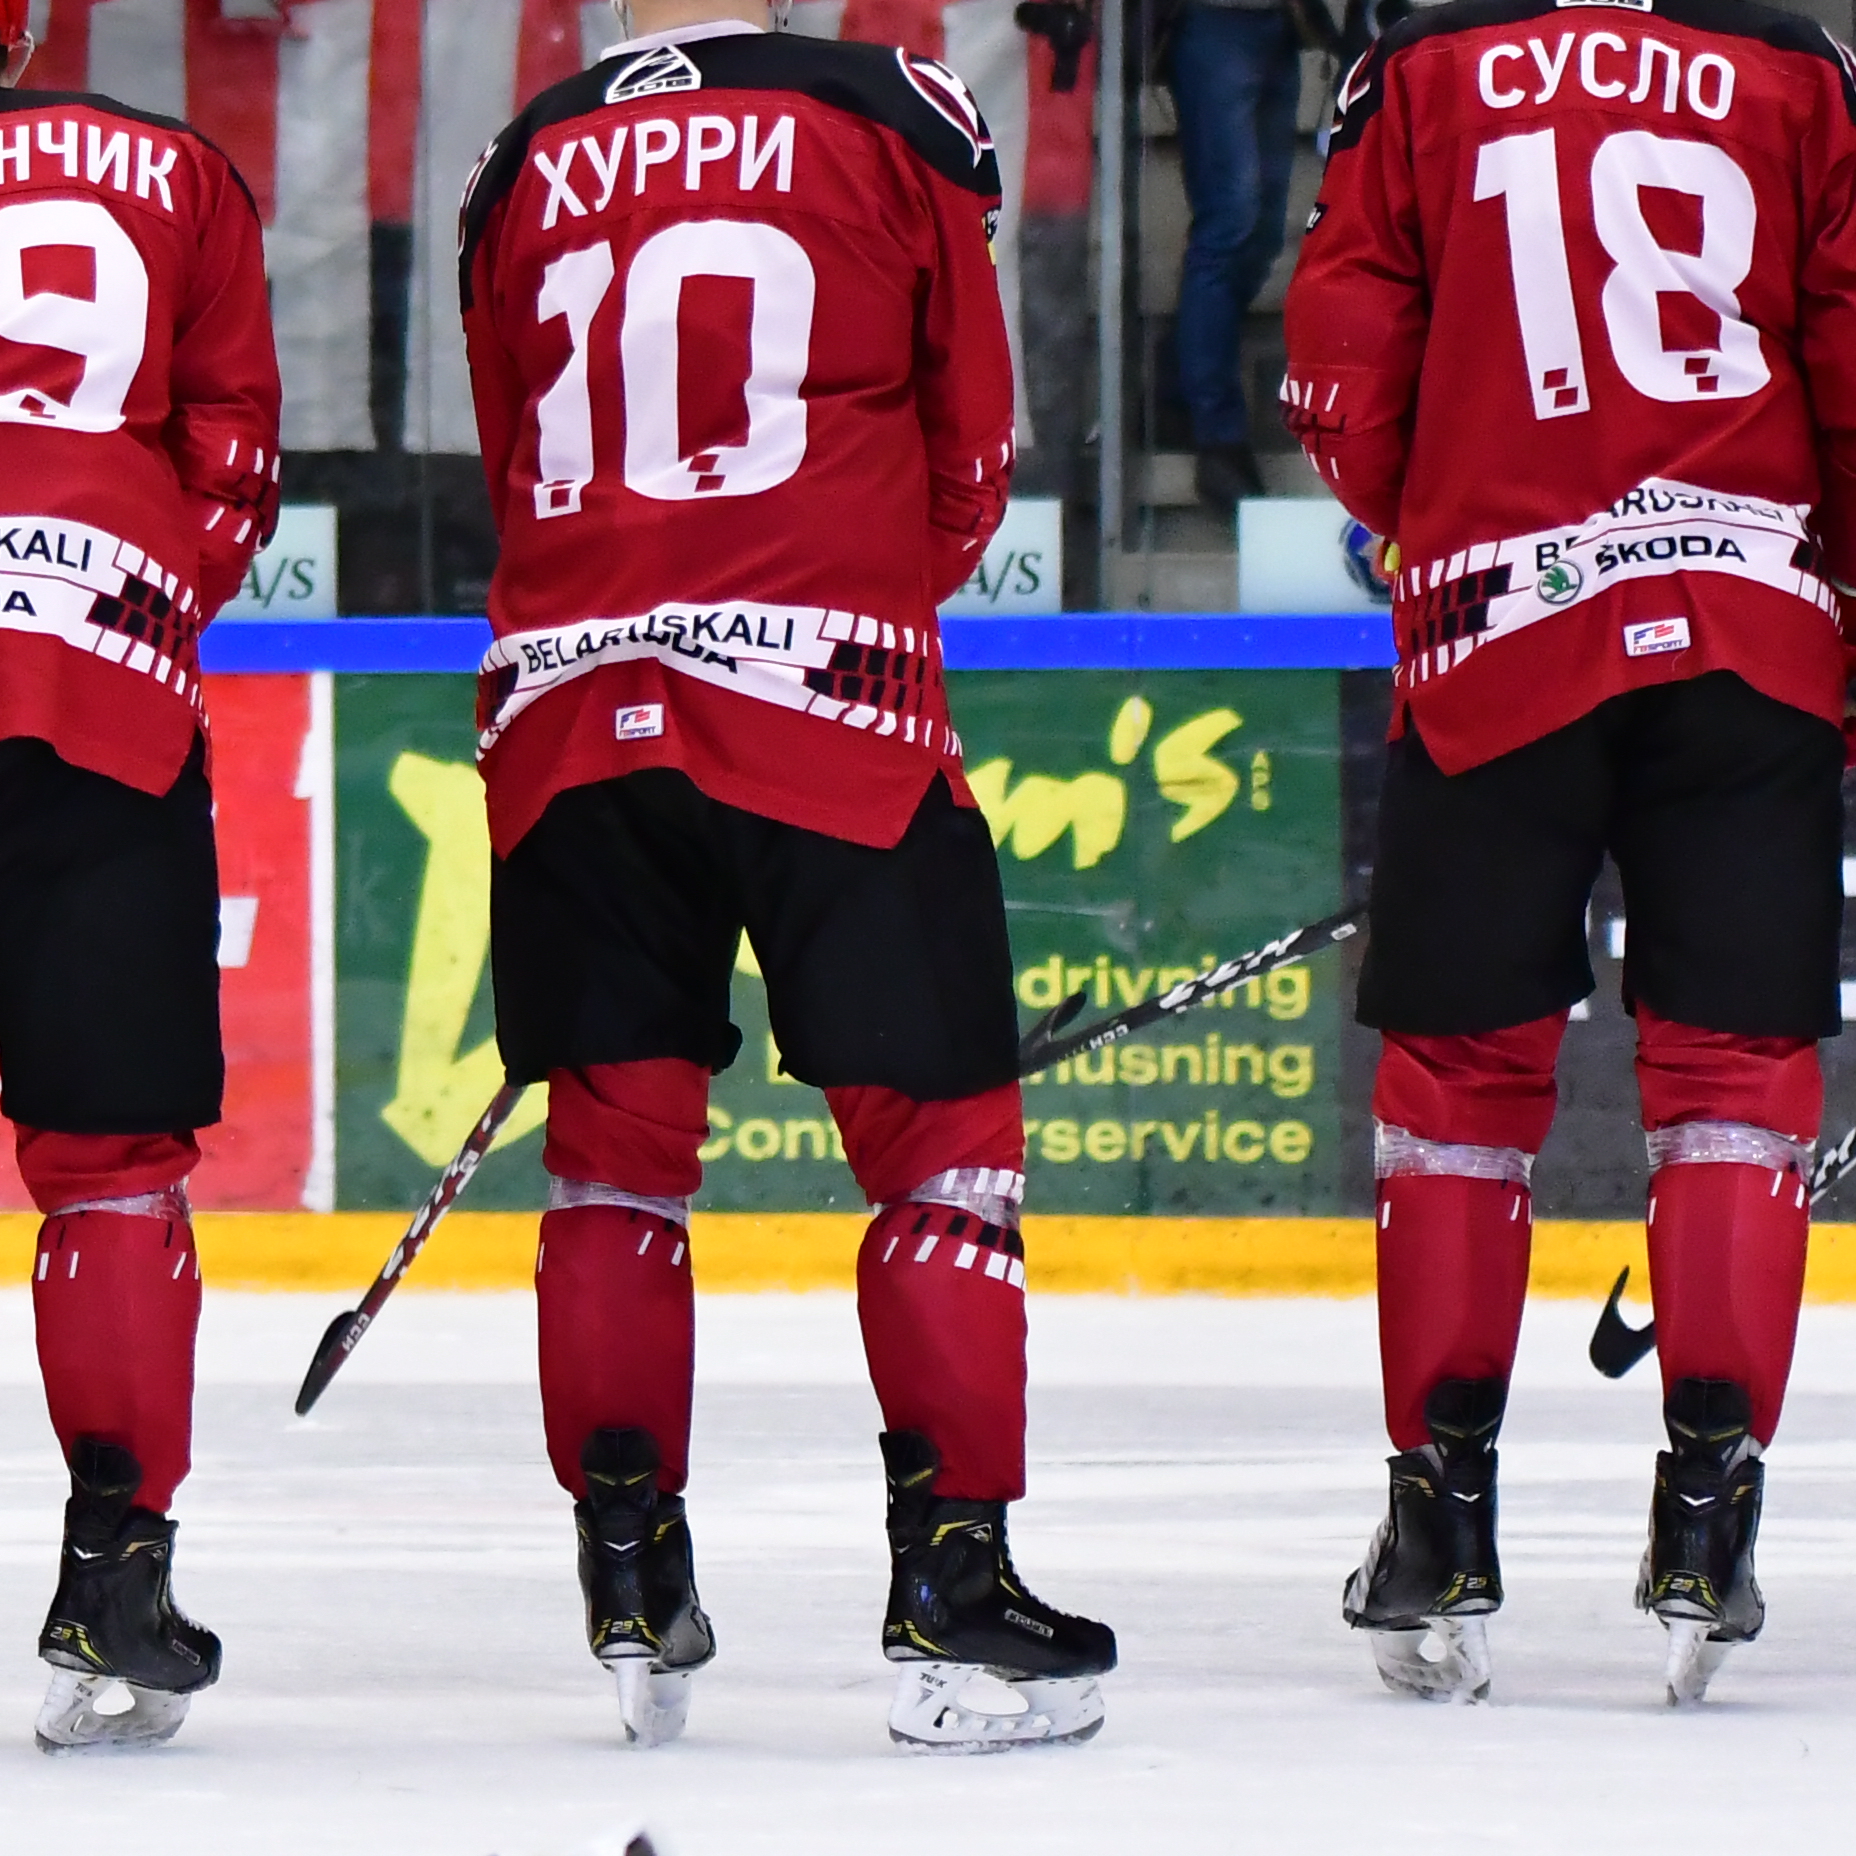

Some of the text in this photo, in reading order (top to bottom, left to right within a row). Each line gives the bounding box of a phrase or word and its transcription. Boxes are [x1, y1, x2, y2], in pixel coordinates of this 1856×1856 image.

[1479, 31, 1736, 121] СУСЛО
[534, 115, 796, 229] ХУРРИ
[1473, 127, 1773, 420] 18
[534, 218, 816, 519] 10
[1596, 535, 1747, 575] ŠKODA
